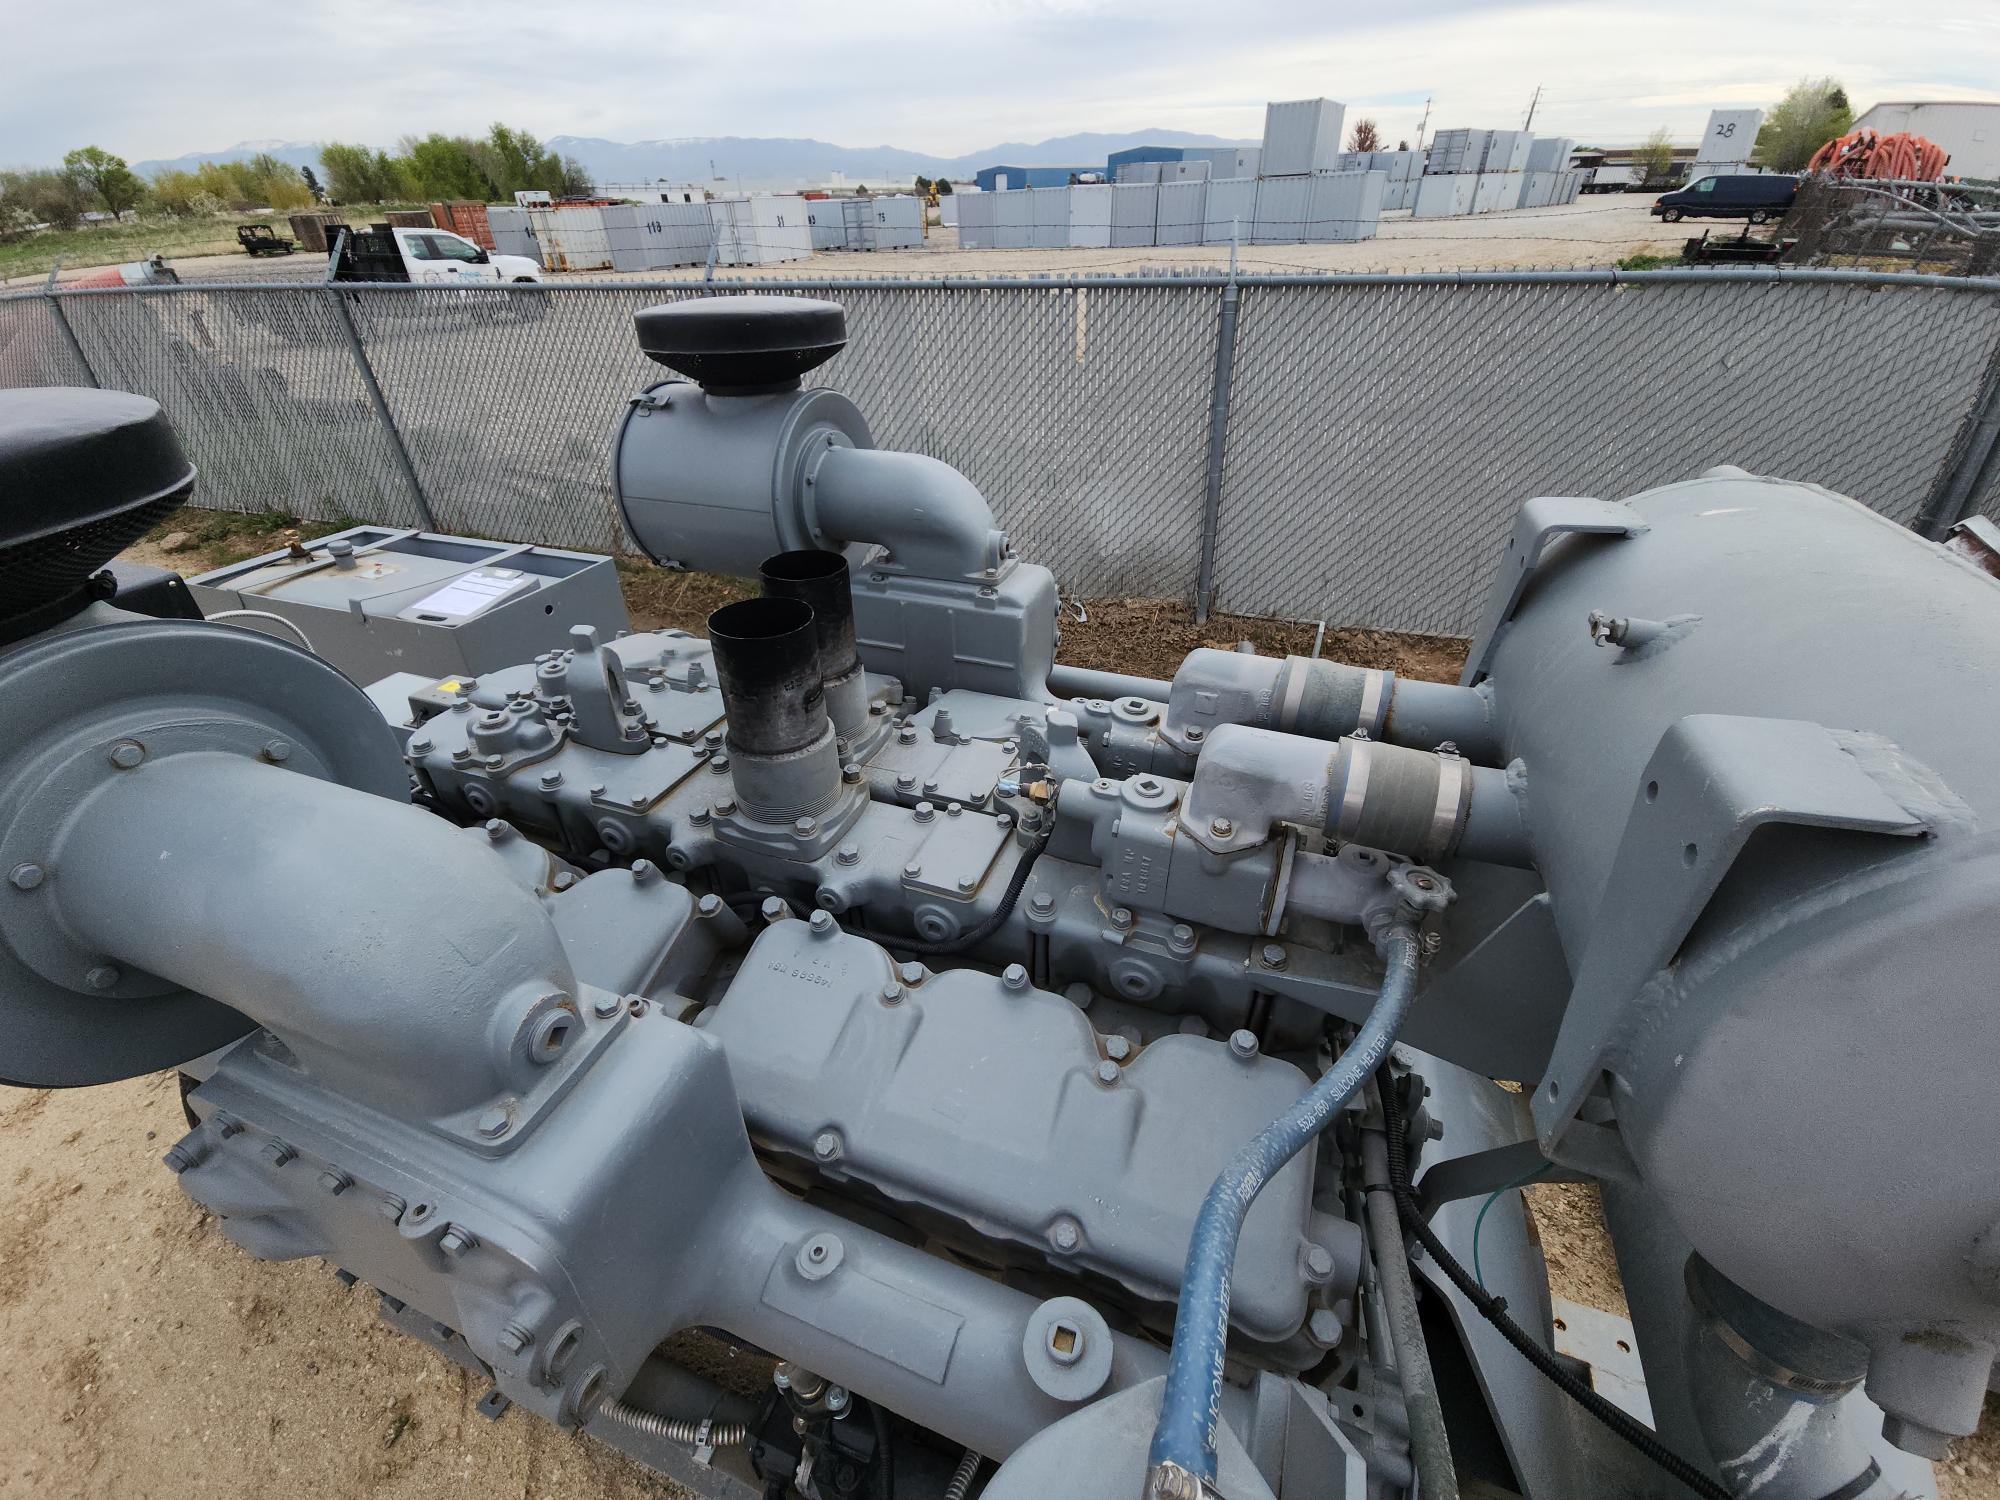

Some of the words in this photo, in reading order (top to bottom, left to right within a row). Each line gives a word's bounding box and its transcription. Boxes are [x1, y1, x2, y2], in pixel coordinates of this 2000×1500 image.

[1715, 122, 1736, 138] 28
[1329, 1064, 1364, 1102] SILICONE
[1359, 1032, 1389, 1070] HEATER
[1216, 1276, 1231, 1349] HEATER
